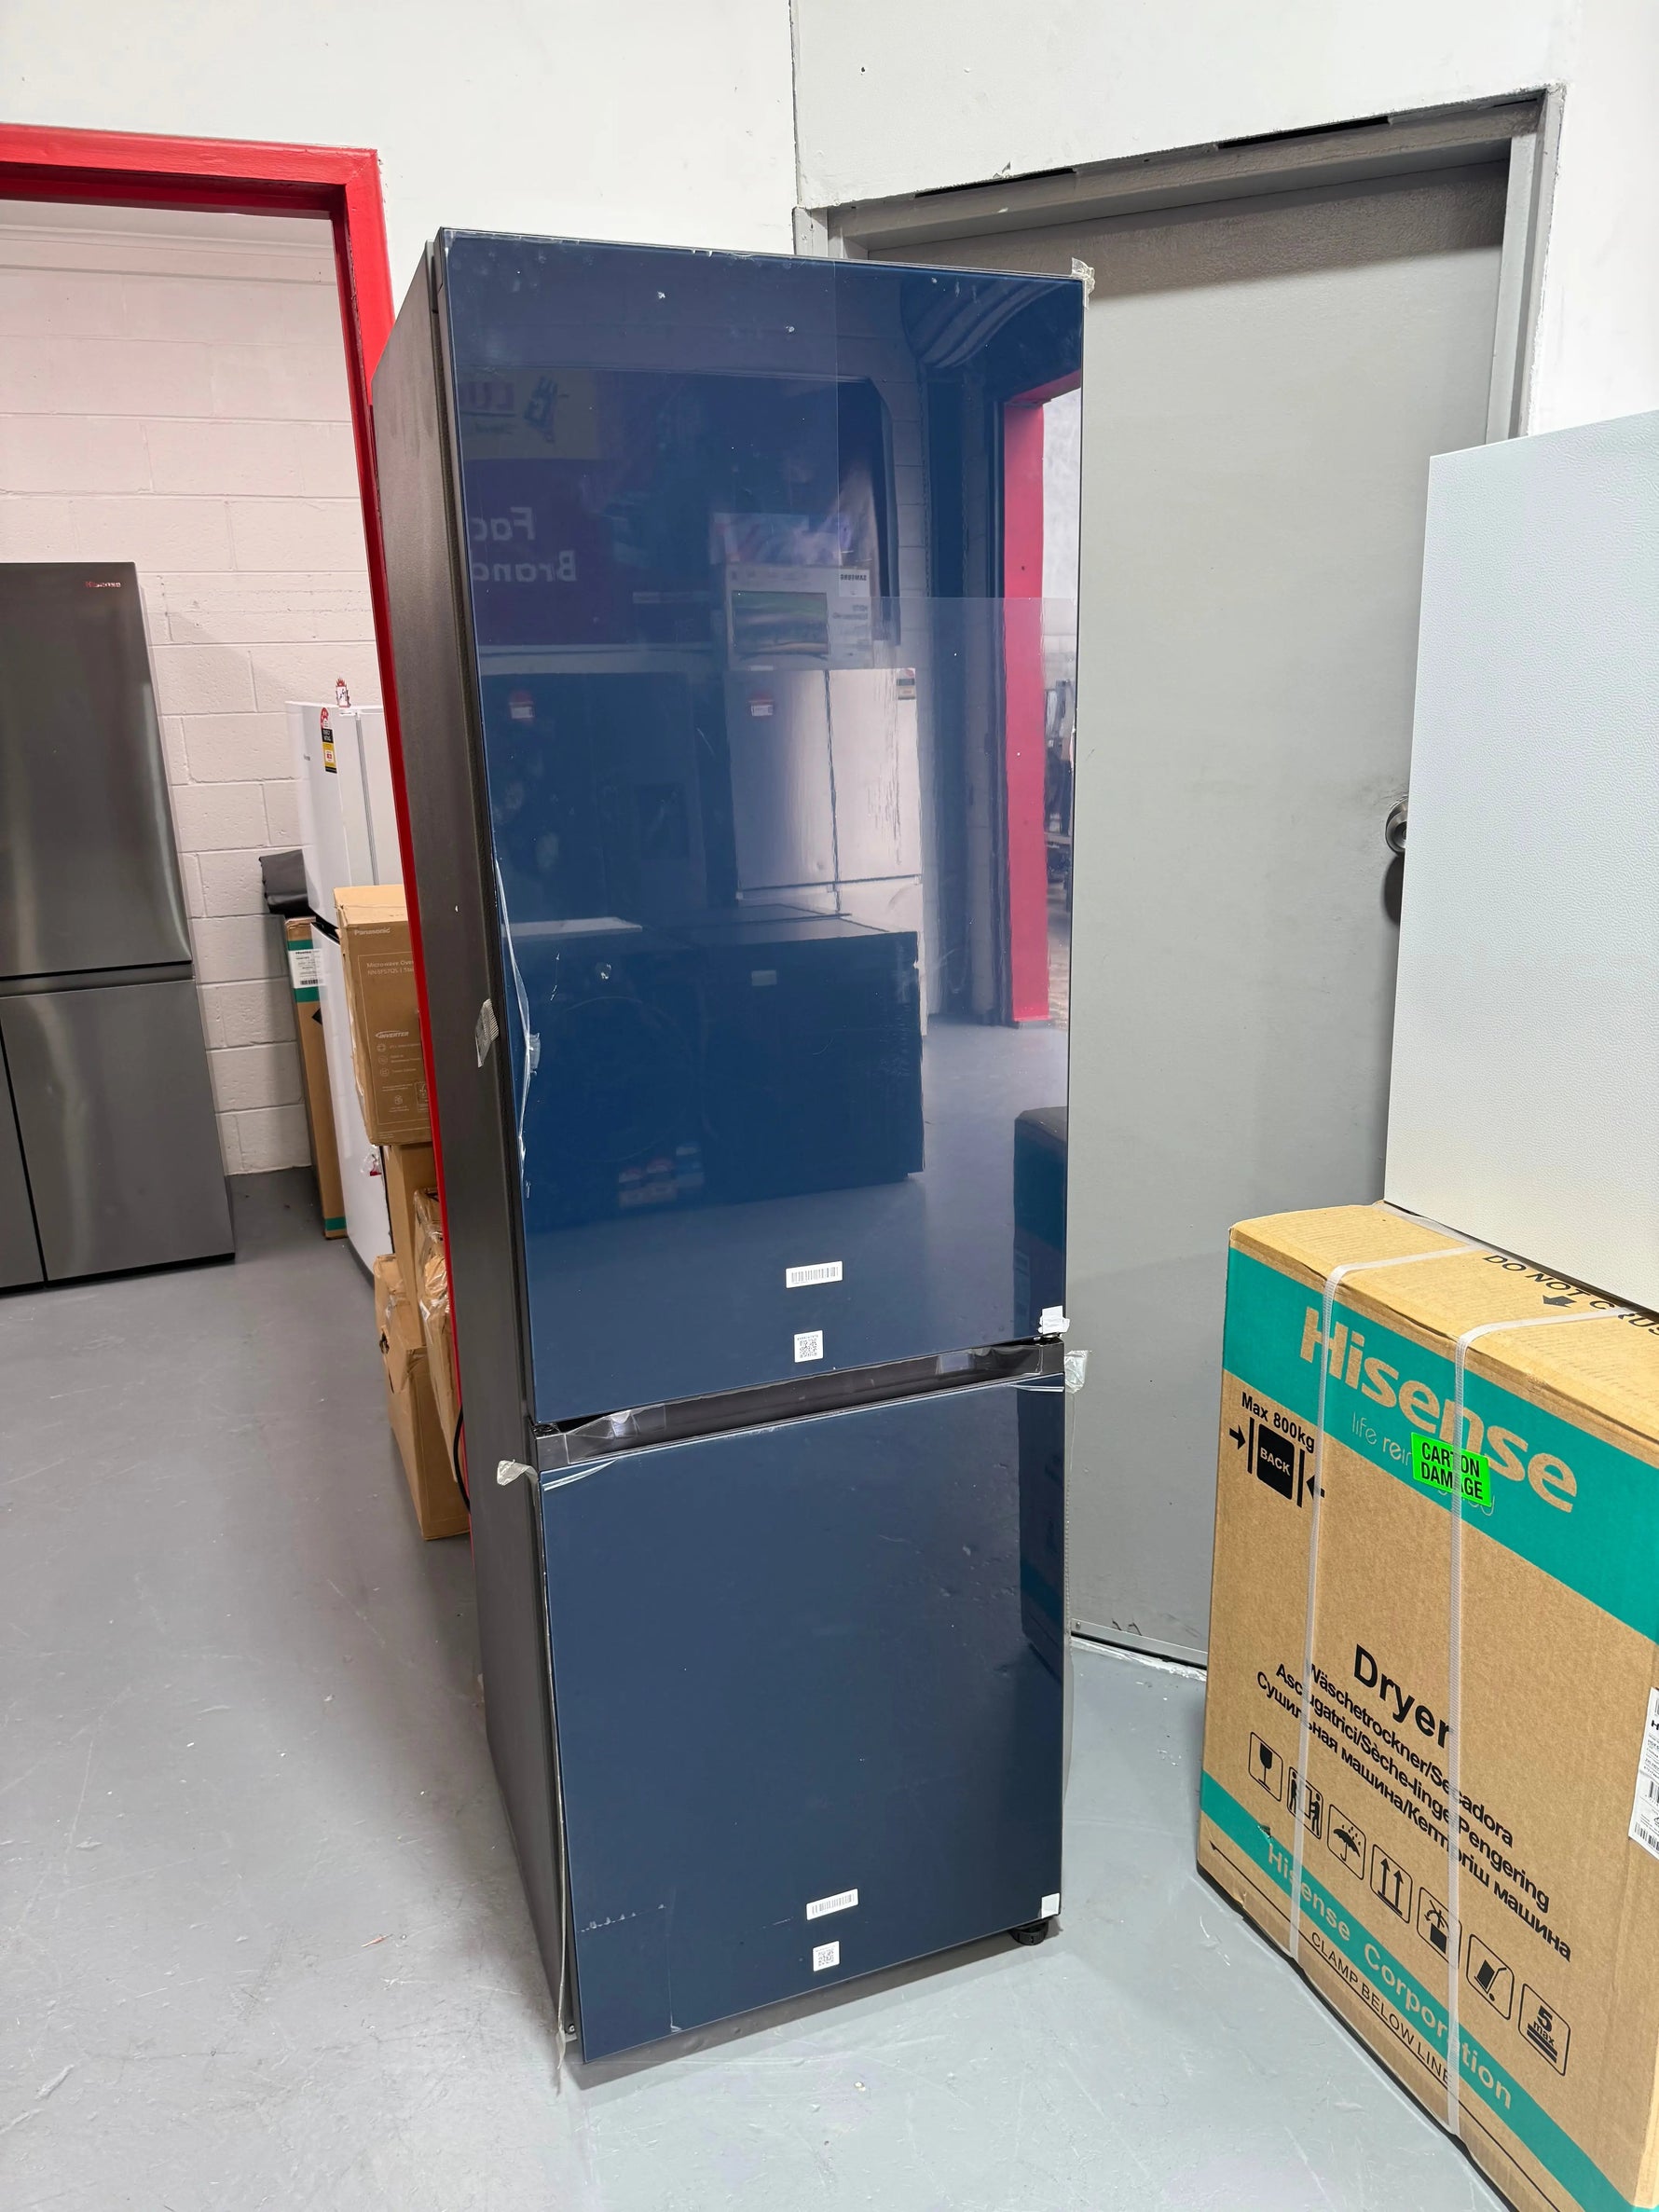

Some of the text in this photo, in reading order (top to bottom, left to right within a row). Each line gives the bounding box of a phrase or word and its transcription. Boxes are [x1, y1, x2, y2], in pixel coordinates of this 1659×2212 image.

[354, 927, 391, 936] Panasonic
[1483, 1255, 1527, 1271] DO
[1525, 1272, 1591, 1297] NOT
[1241, 1392, 1315, 1454] Max 800kg
[1300, 1307, 1577, 1513] Hisense
[1352, 1411, 1378, 1445] life
[1259, 1447, 1291, 1477] BACK
[1354, 1643, 1452, 1748] Dryer
[1494, 1881, 1570, 1962] машина
[1311, 1931, 1452, 2088] CLAMP BELOW LINE
[1364, 1943, 1512, 2109] Corportion
[1532, 2020, 1555, 2047] max
[1536, 2004, 1553, 2032] 5
